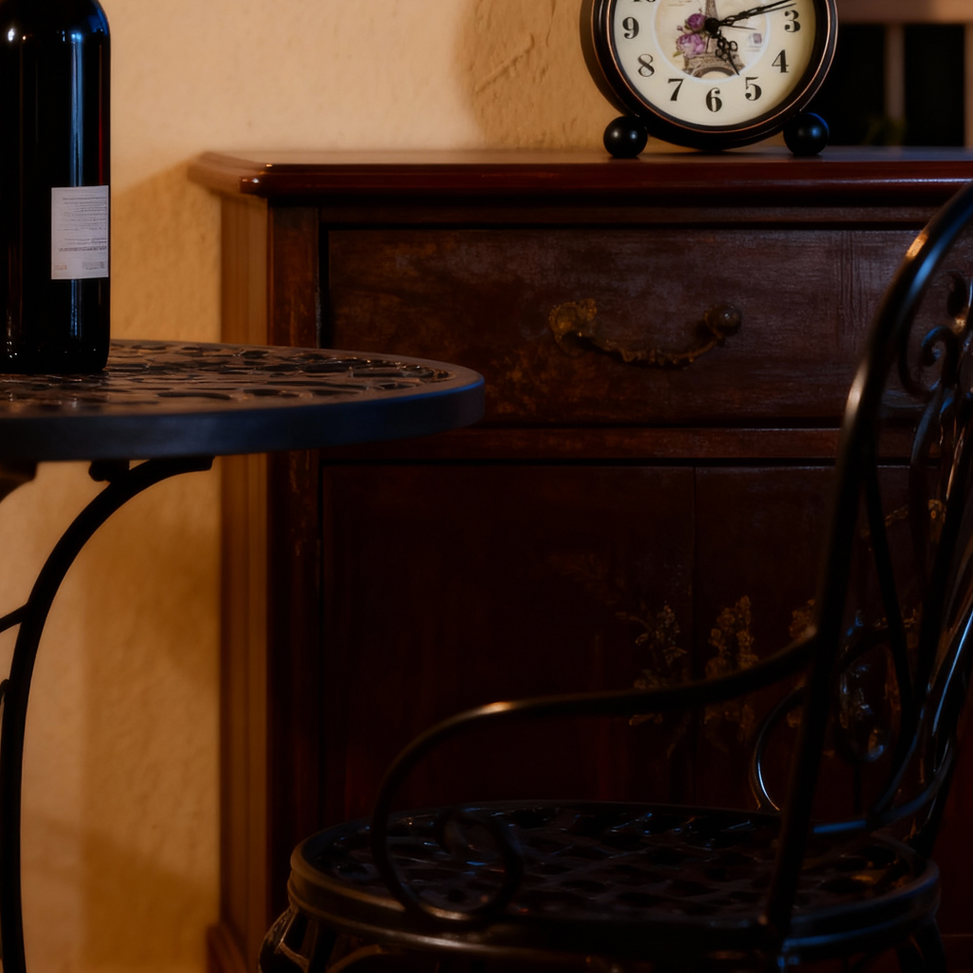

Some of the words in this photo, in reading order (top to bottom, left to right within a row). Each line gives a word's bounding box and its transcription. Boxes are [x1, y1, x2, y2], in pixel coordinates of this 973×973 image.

[622, 17, 639, 39] 9
[784, 10, 801, 32] 3
[637, 54, 655, 77] 8
[772, 49, 789, 73] 4
[668, 78, 684, 102] 7
[706, 87, 723, 112] 6
[745, 77, 762, 101] 5
